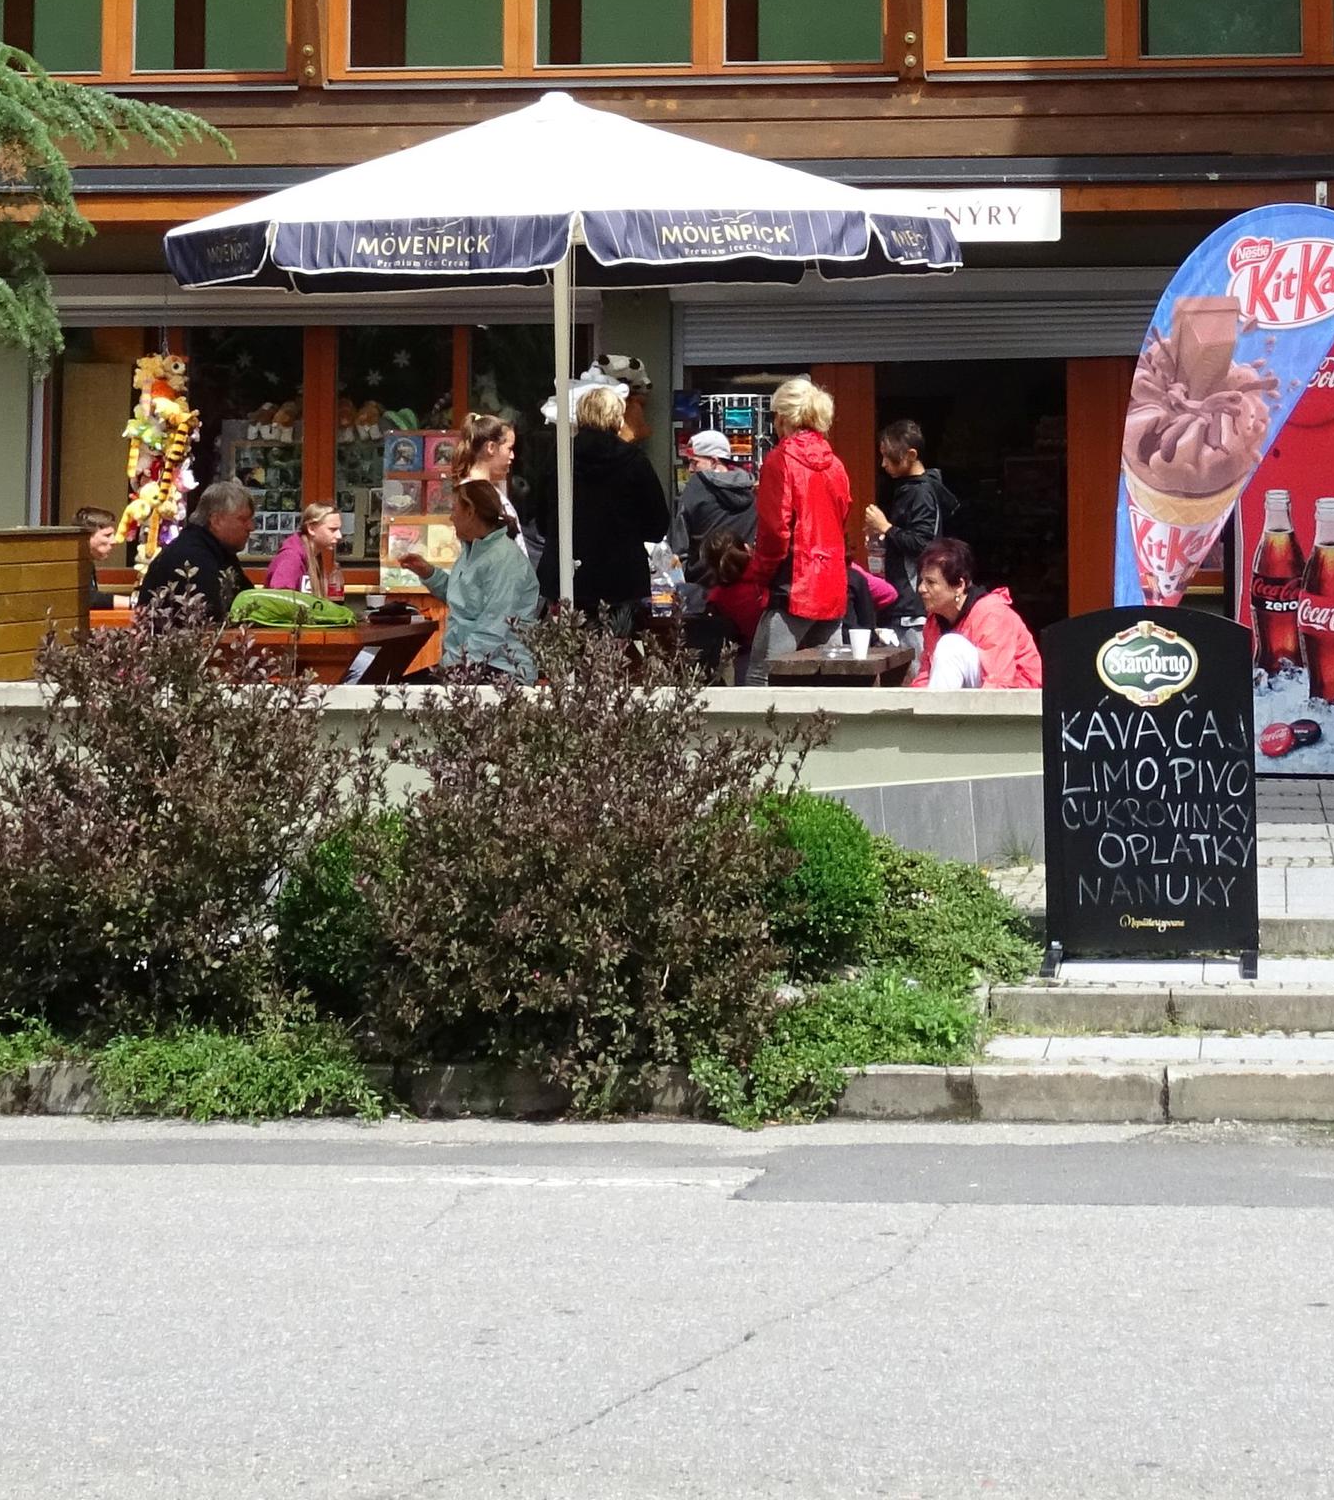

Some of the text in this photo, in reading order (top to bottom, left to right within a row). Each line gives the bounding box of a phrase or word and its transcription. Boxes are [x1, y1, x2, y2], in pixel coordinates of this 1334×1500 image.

[926, 200, 1022, 225] NÝRY
[1265, 600, 1298, 611] zero
[1104, 644, 1189, 684] Starobrno
[1062, 797, 1252, 834] CUKROVINKY
[1098, 832, 1254, 868] OPLATKY
[1078, 874, 1236, 907] NANUKY
